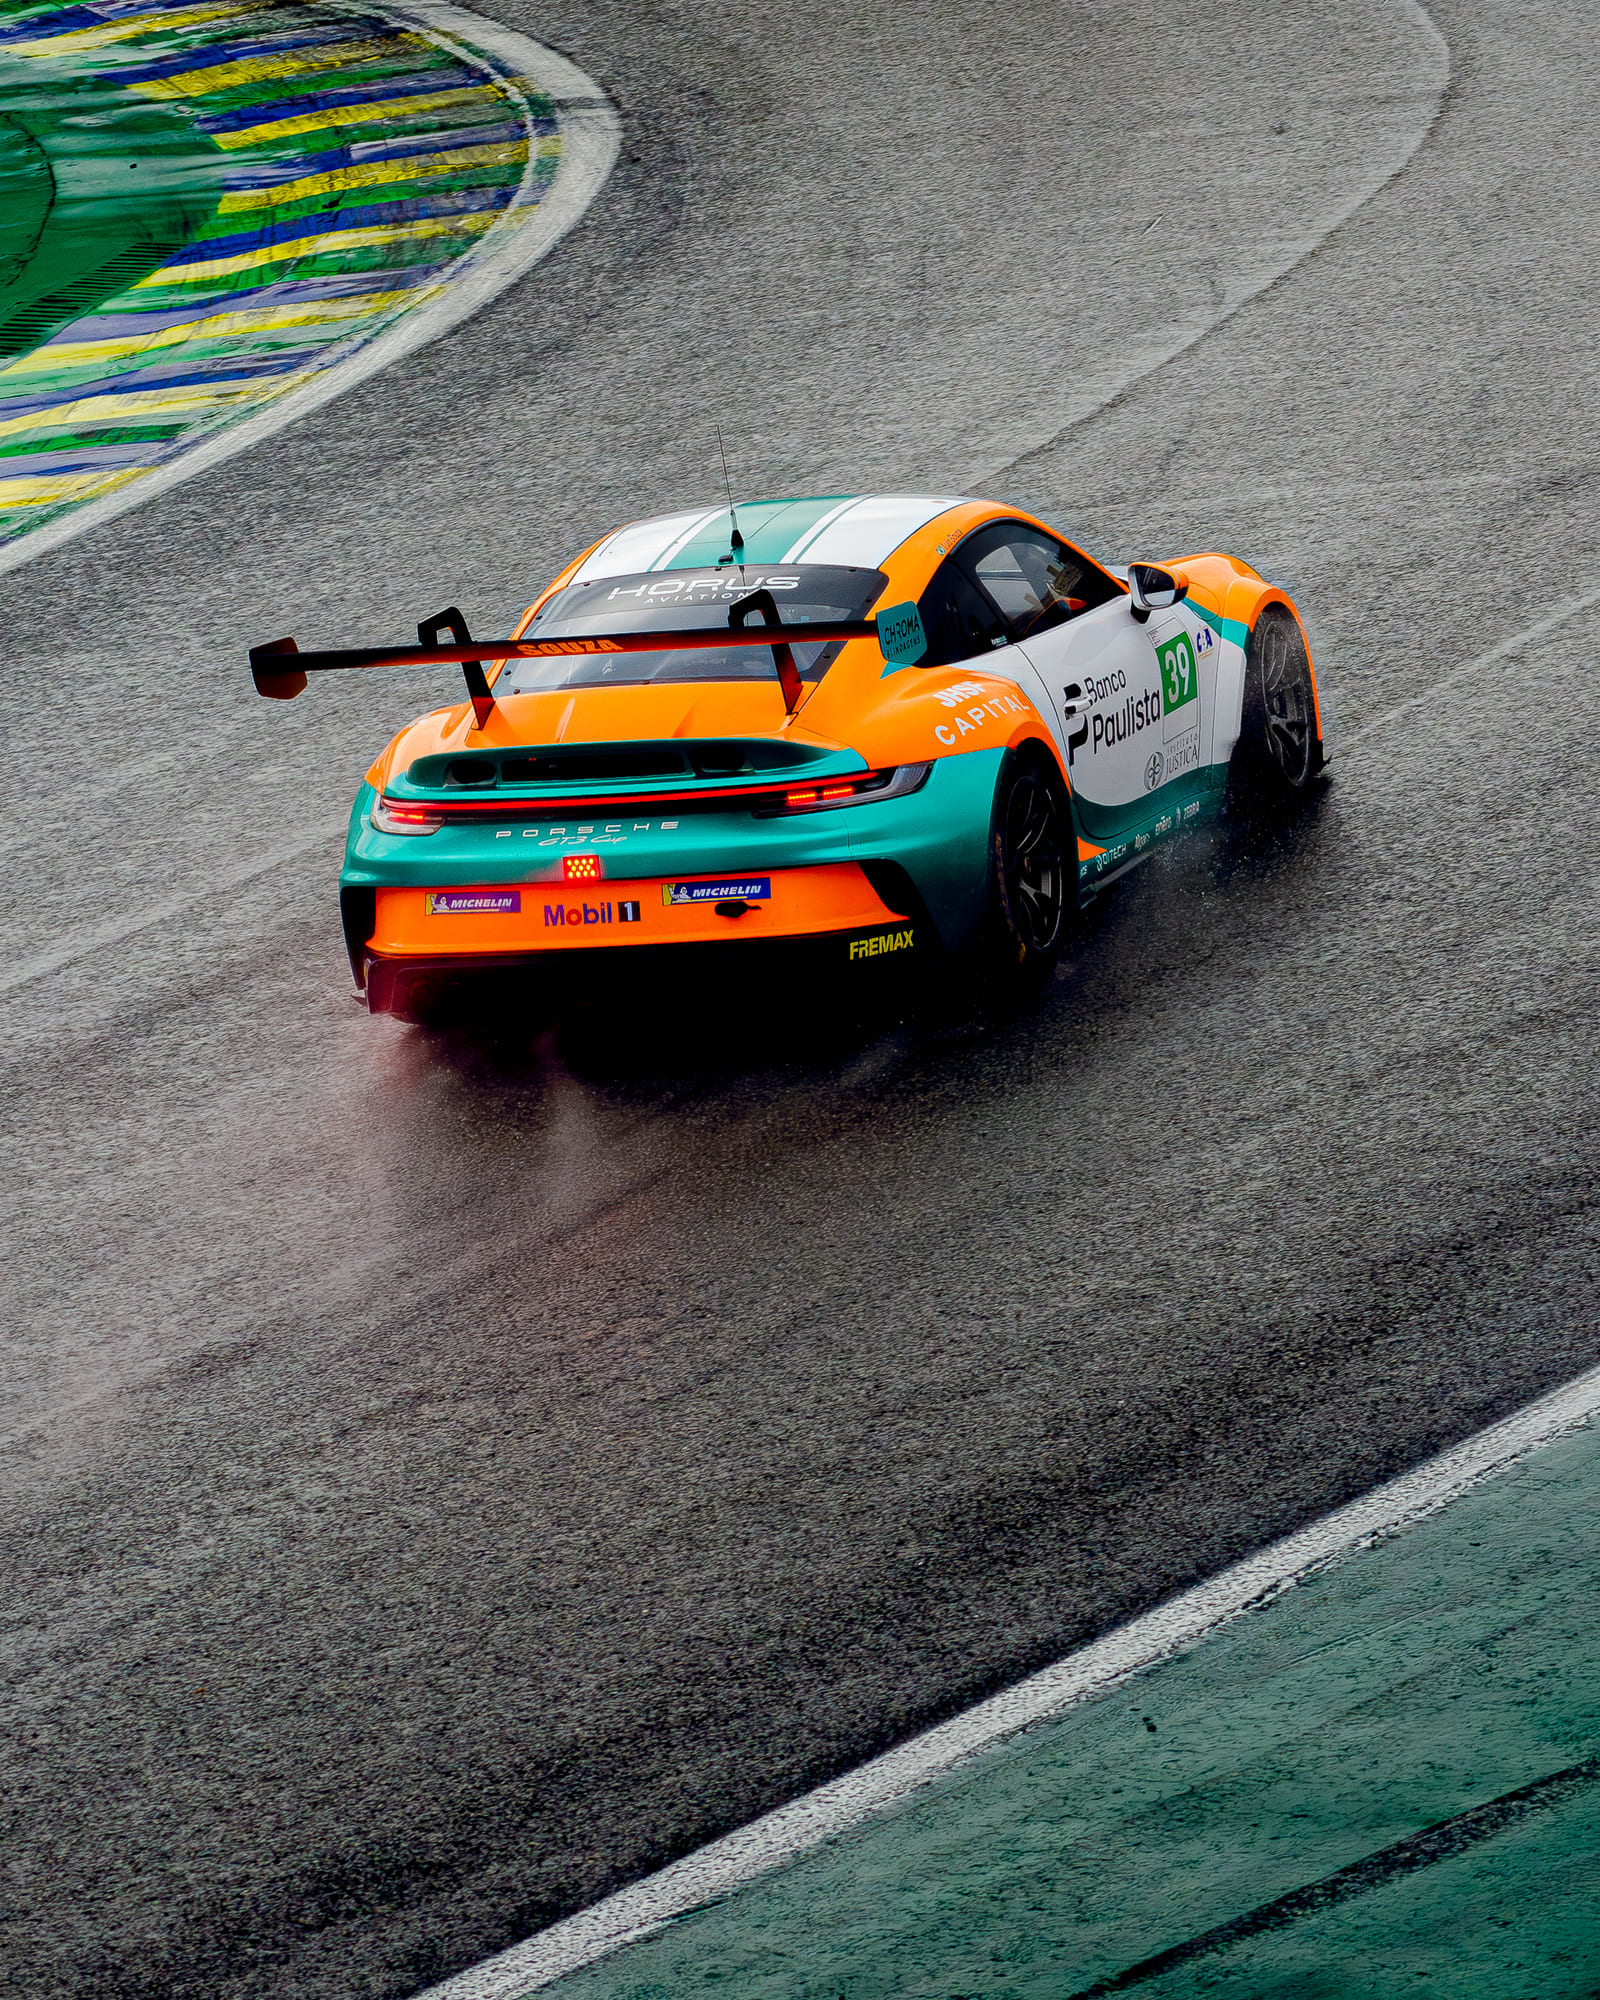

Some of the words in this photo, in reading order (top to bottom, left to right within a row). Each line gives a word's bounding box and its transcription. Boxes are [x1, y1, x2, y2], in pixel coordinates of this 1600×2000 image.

[644, 592, 750, 604] AVIATION
[884, 613, 920, 645] CHROMA
[516, 639, 624, 656] SOUZA
[1164, 642, 1190, 703] 39
[1083, 669, 1126, 703] Banco
[935, 694, 1030, 745] CAPITAL
[1092, 688, 1160, 754] Paulista
[495, 821, 679, 839] PORSCHE
[538, 836, 588, 847] GT3
[590, 834, 628, 846] Cup
[450, 898, 513, 909] MICHELIN
[692, 884, 762, 898] MICHELIN
[544, 902, 613, 927] Mobil
[849, 929, 914, 960] FREMAX
